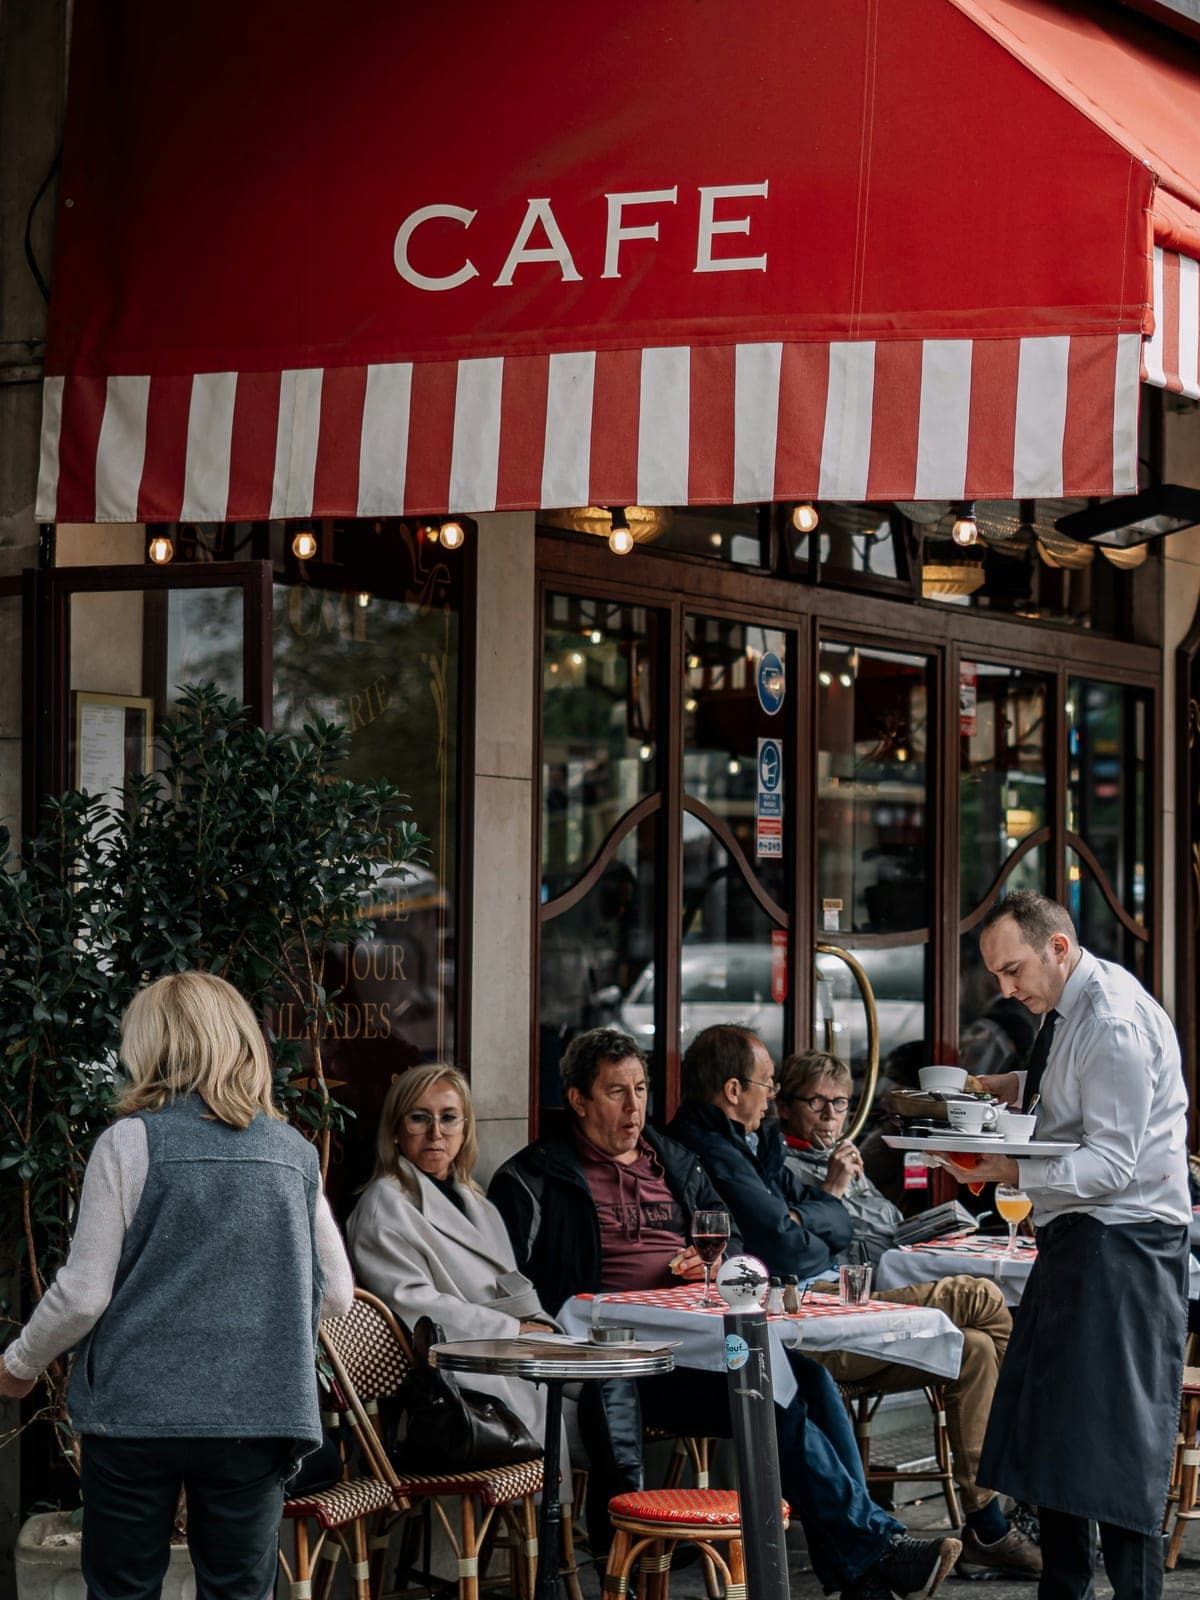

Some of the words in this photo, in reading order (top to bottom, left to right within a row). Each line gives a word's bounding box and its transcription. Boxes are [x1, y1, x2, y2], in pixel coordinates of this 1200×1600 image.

[393, 180, 769, 292] CAFE
[339, 943, 408, 990] JOUR
[645, 1202, 673, 1222] EASY
